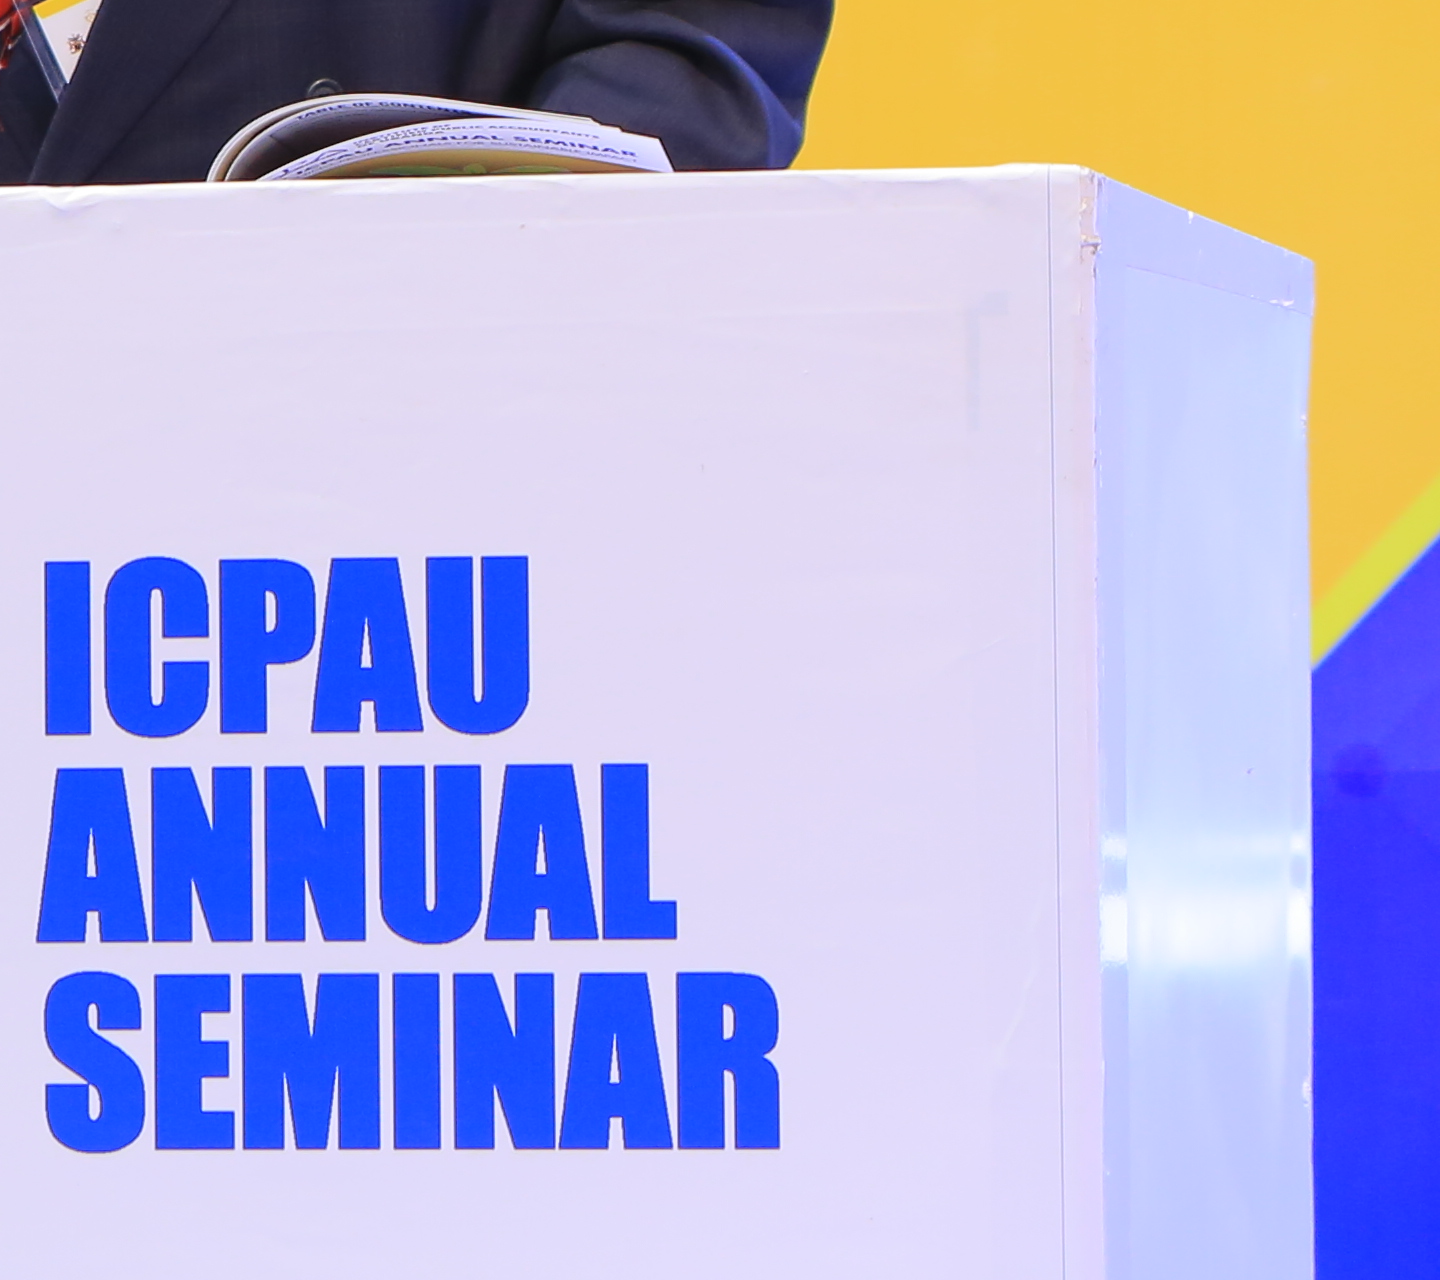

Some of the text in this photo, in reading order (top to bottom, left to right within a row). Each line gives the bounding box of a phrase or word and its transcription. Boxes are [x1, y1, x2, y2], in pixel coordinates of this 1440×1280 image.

[297, 104, 344, 121] TABLE
[384, 134, 505, 149] ANNUAL
[513, 135, 638, 158] SEMINAR
[41, 553, 532, 740] ICPAU
[35, 761, 680, 946] ANNUAL
[41, 969, 783, 1155] SEMINAR
